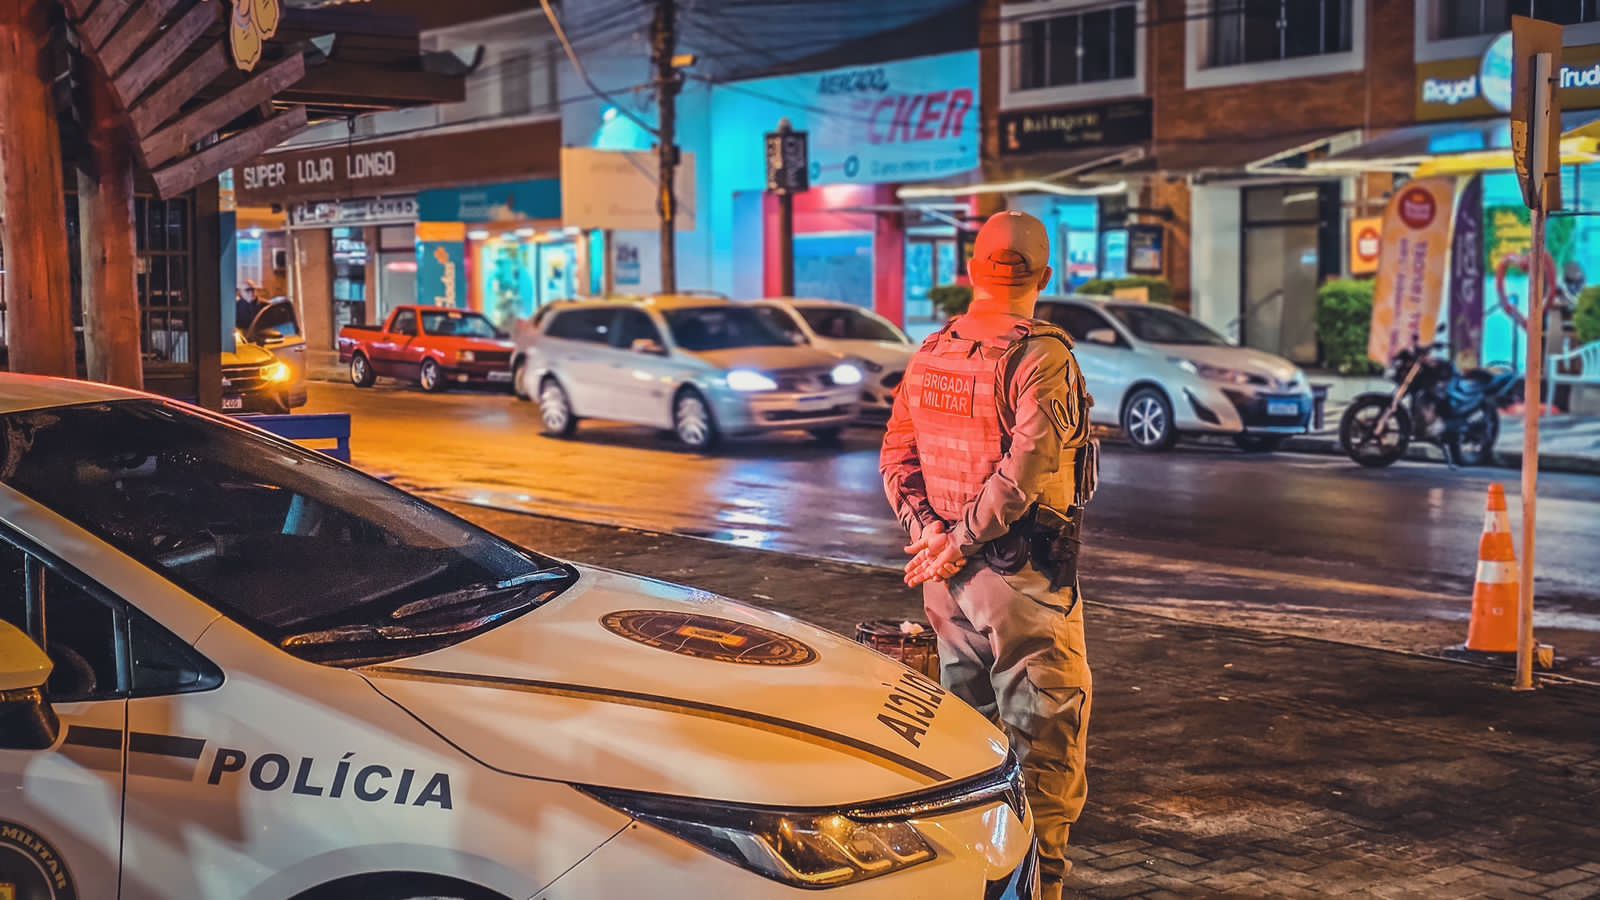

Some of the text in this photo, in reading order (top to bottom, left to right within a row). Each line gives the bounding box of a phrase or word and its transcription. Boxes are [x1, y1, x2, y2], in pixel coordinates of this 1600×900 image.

[1423, 75, 1477, 105] Royal
[852, 88, 974, 145] CKER
[243, 151, 396, 189] SUPER LOJA LONGO
[923, 373, 972, 394] BRIGADA
[923, 390, 969, 415] MILITAR
[207, 747, 453, 810] POLÍCIA
[1, 825, 67, 889] MILITAR
